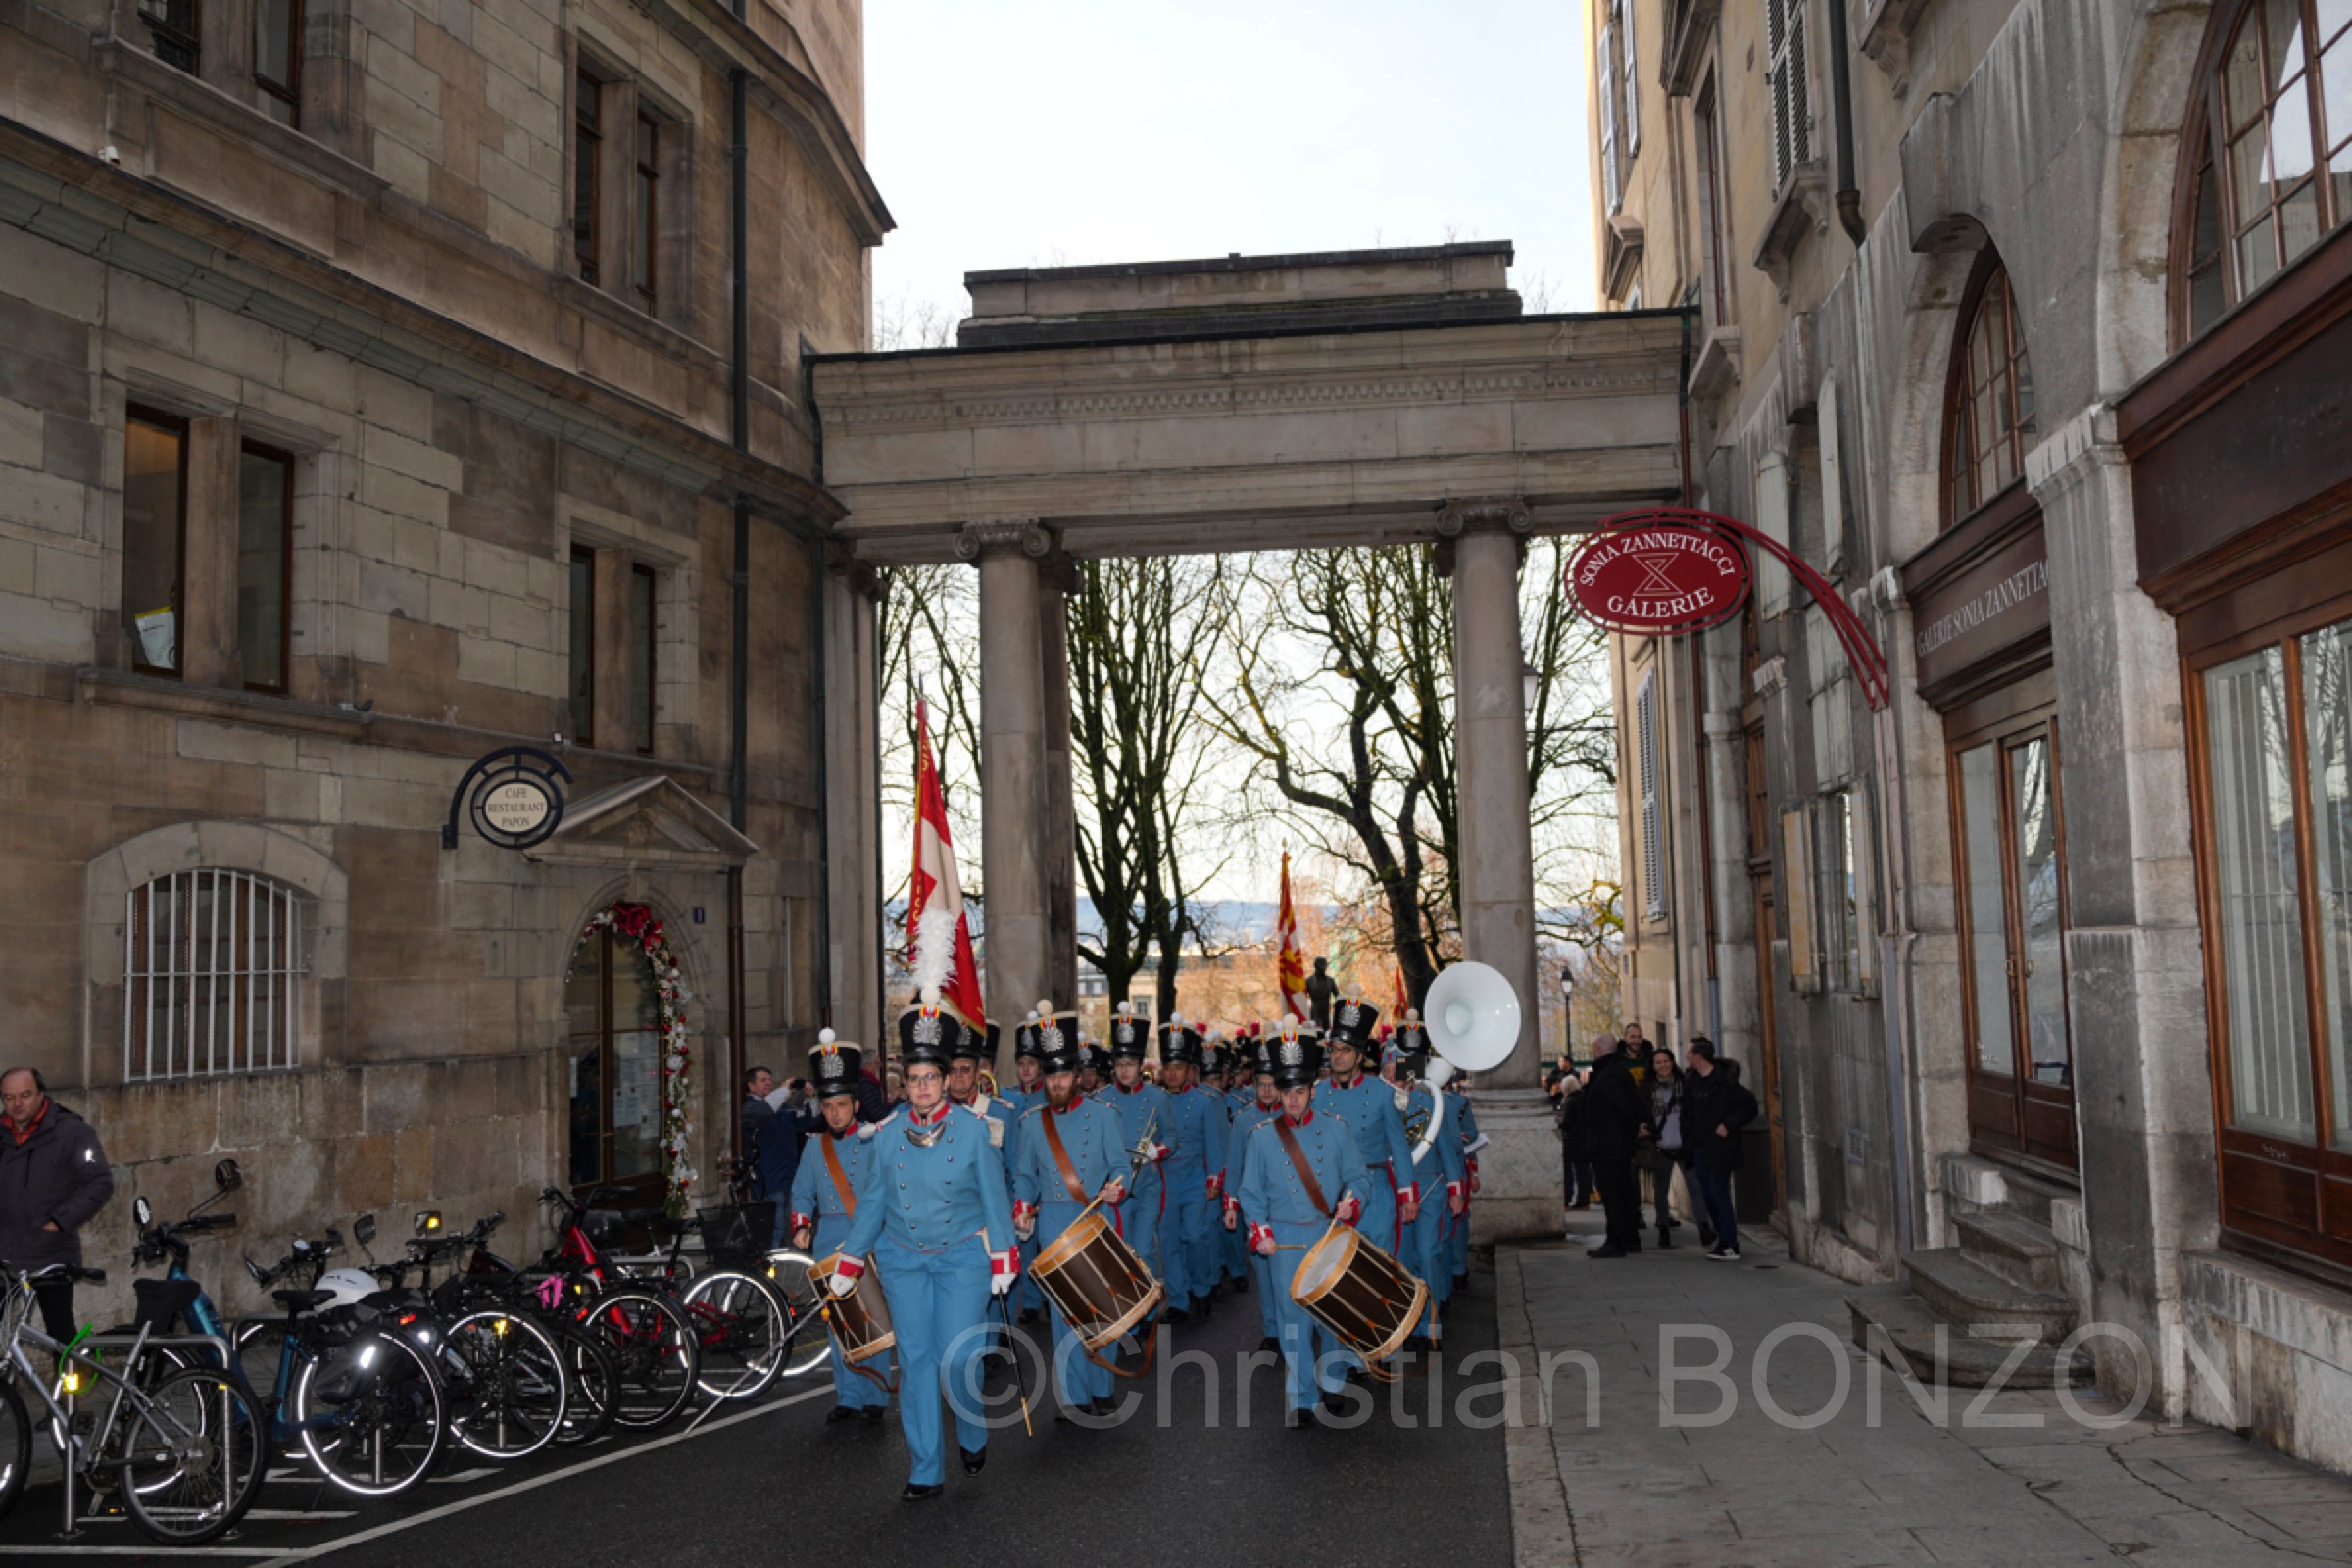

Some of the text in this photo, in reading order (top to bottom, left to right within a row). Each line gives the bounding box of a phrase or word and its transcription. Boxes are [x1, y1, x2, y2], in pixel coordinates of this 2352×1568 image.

[1580, 532, 1736, 587] SONIA ZANNETTACCI
[1607, 586, 1714, 618] GALERIE
[1917, 558, 2049, 657] GALERIE SONIA ZANNETTA
[487, 802, 545, 812] RESTAURANT
